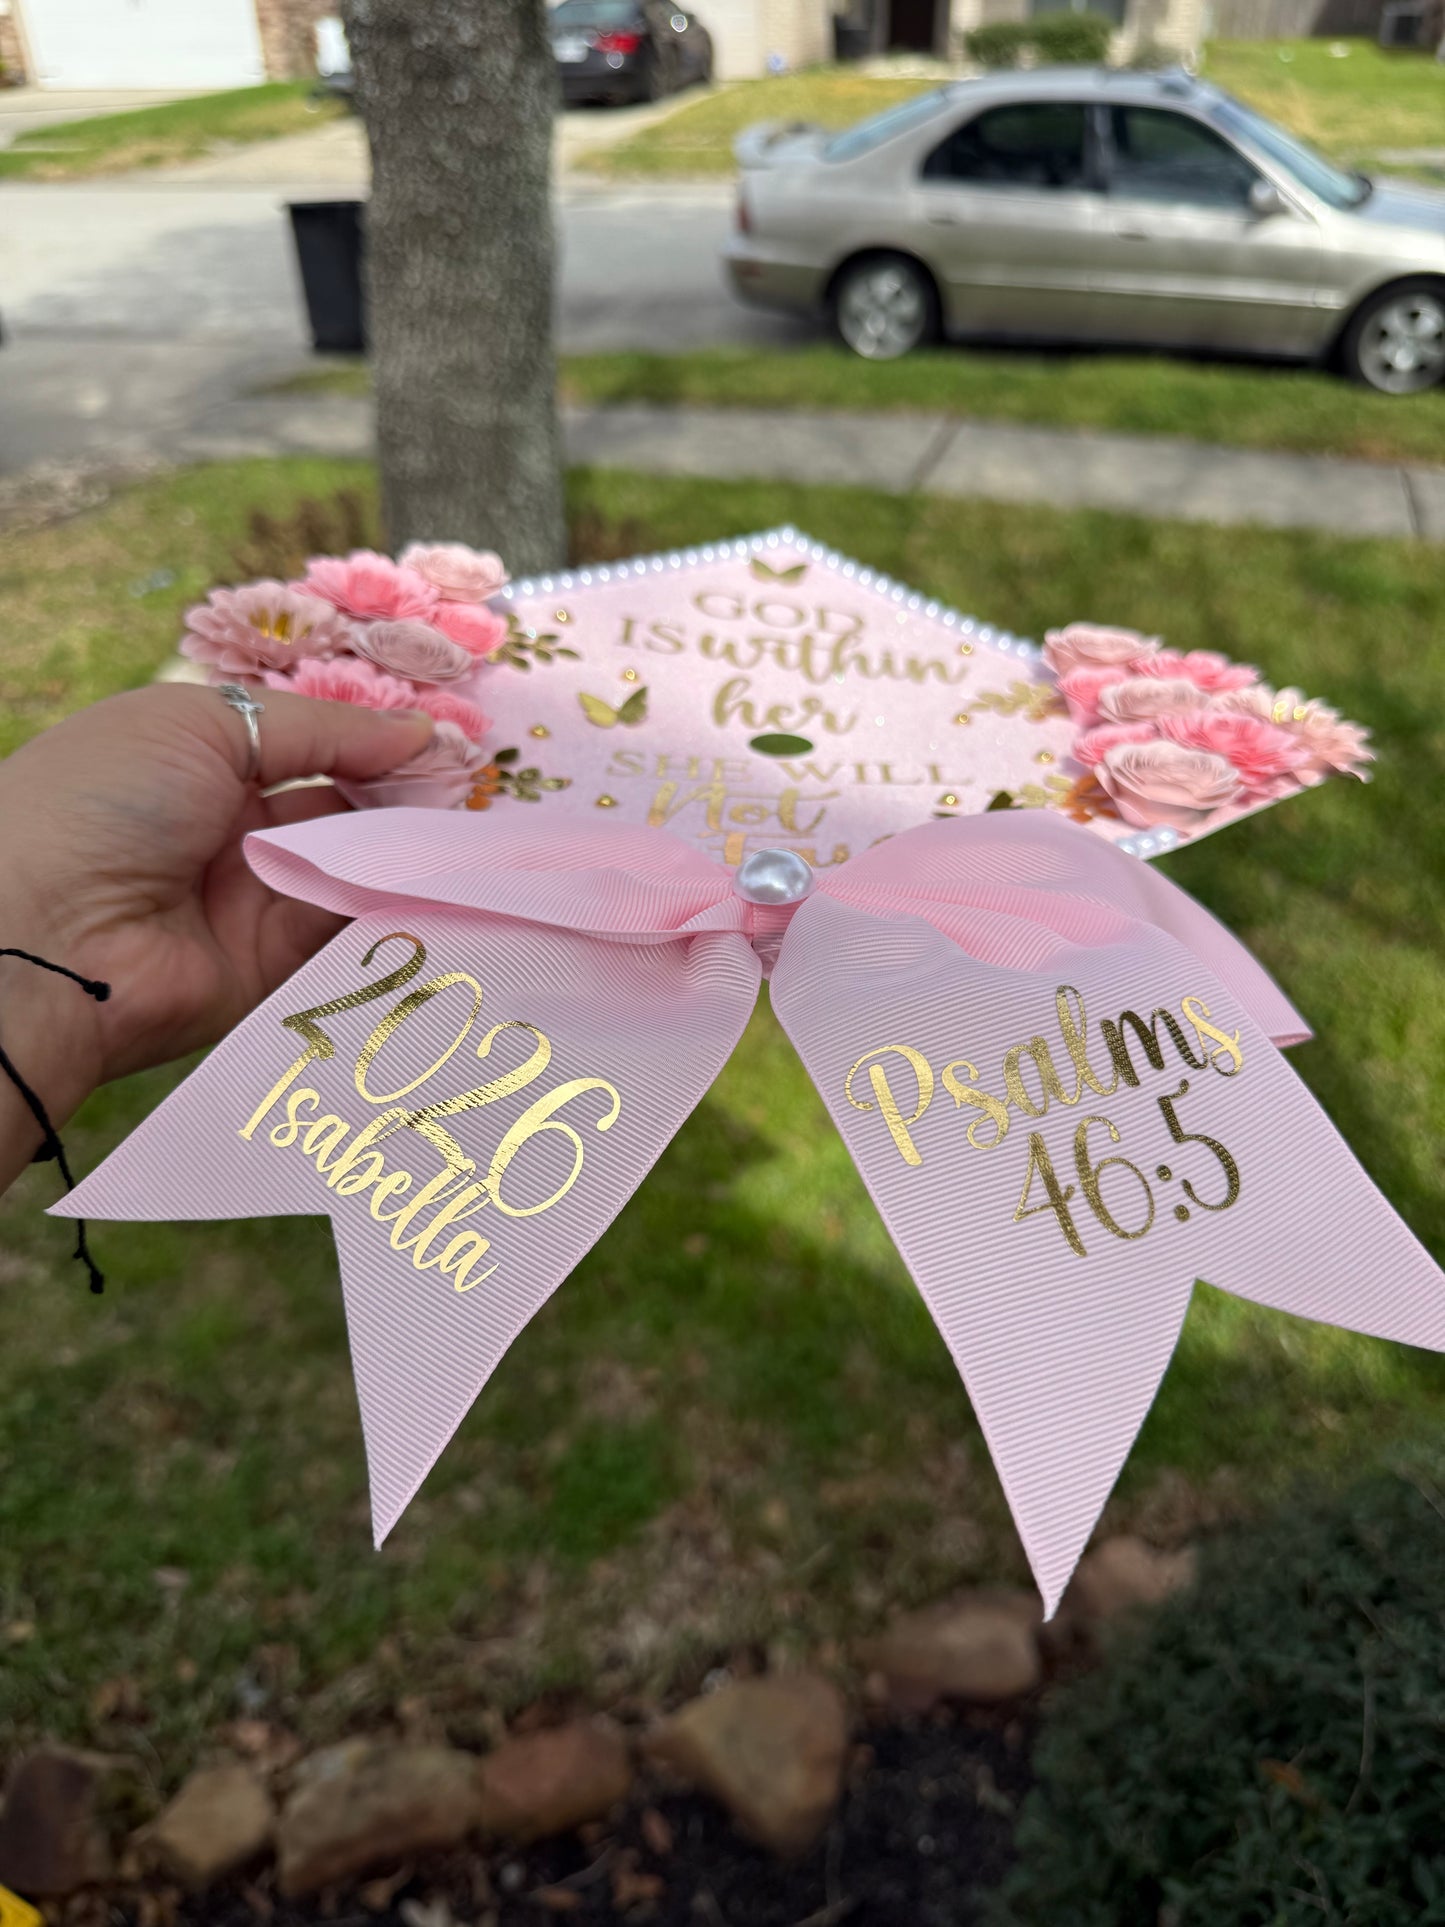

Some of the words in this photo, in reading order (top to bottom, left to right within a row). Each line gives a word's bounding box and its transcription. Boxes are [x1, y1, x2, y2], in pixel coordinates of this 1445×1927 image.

[620, 617, 686, 654] IS
[700, 632, 970, 685] within
[693, 590, 864, 634] GOD
[711, 677, 858, 734] her
[606, 750, 751, 782] SHE
[777, 761, 974, 787] WILL
[281, 931, 621, 1218] 2026
[844, 985, 1244, 1167] Psalms
[237, 1043, 500, 1293] Isabella
[1012, 1078, 1241, 1257] 46:5
